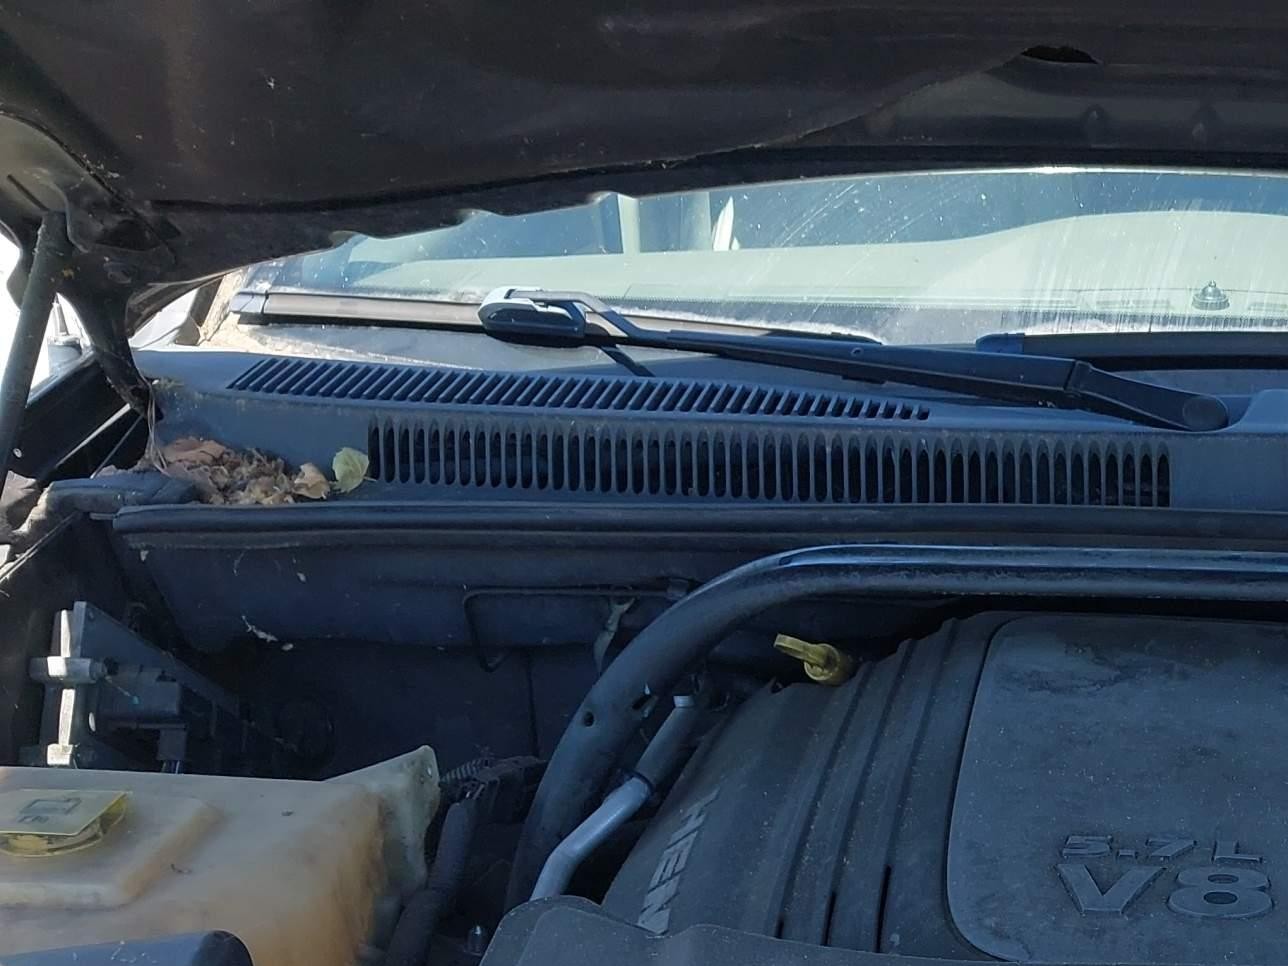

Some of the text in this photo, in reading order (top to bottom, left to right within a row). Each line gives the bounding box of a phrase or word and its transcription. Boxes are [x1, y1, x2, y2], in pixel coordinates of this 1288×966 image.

[638, 786, 720, 934] HEM
[1060, 834, 1265, 863] 5.7L
[1054, 863, 1275, 918] V8
